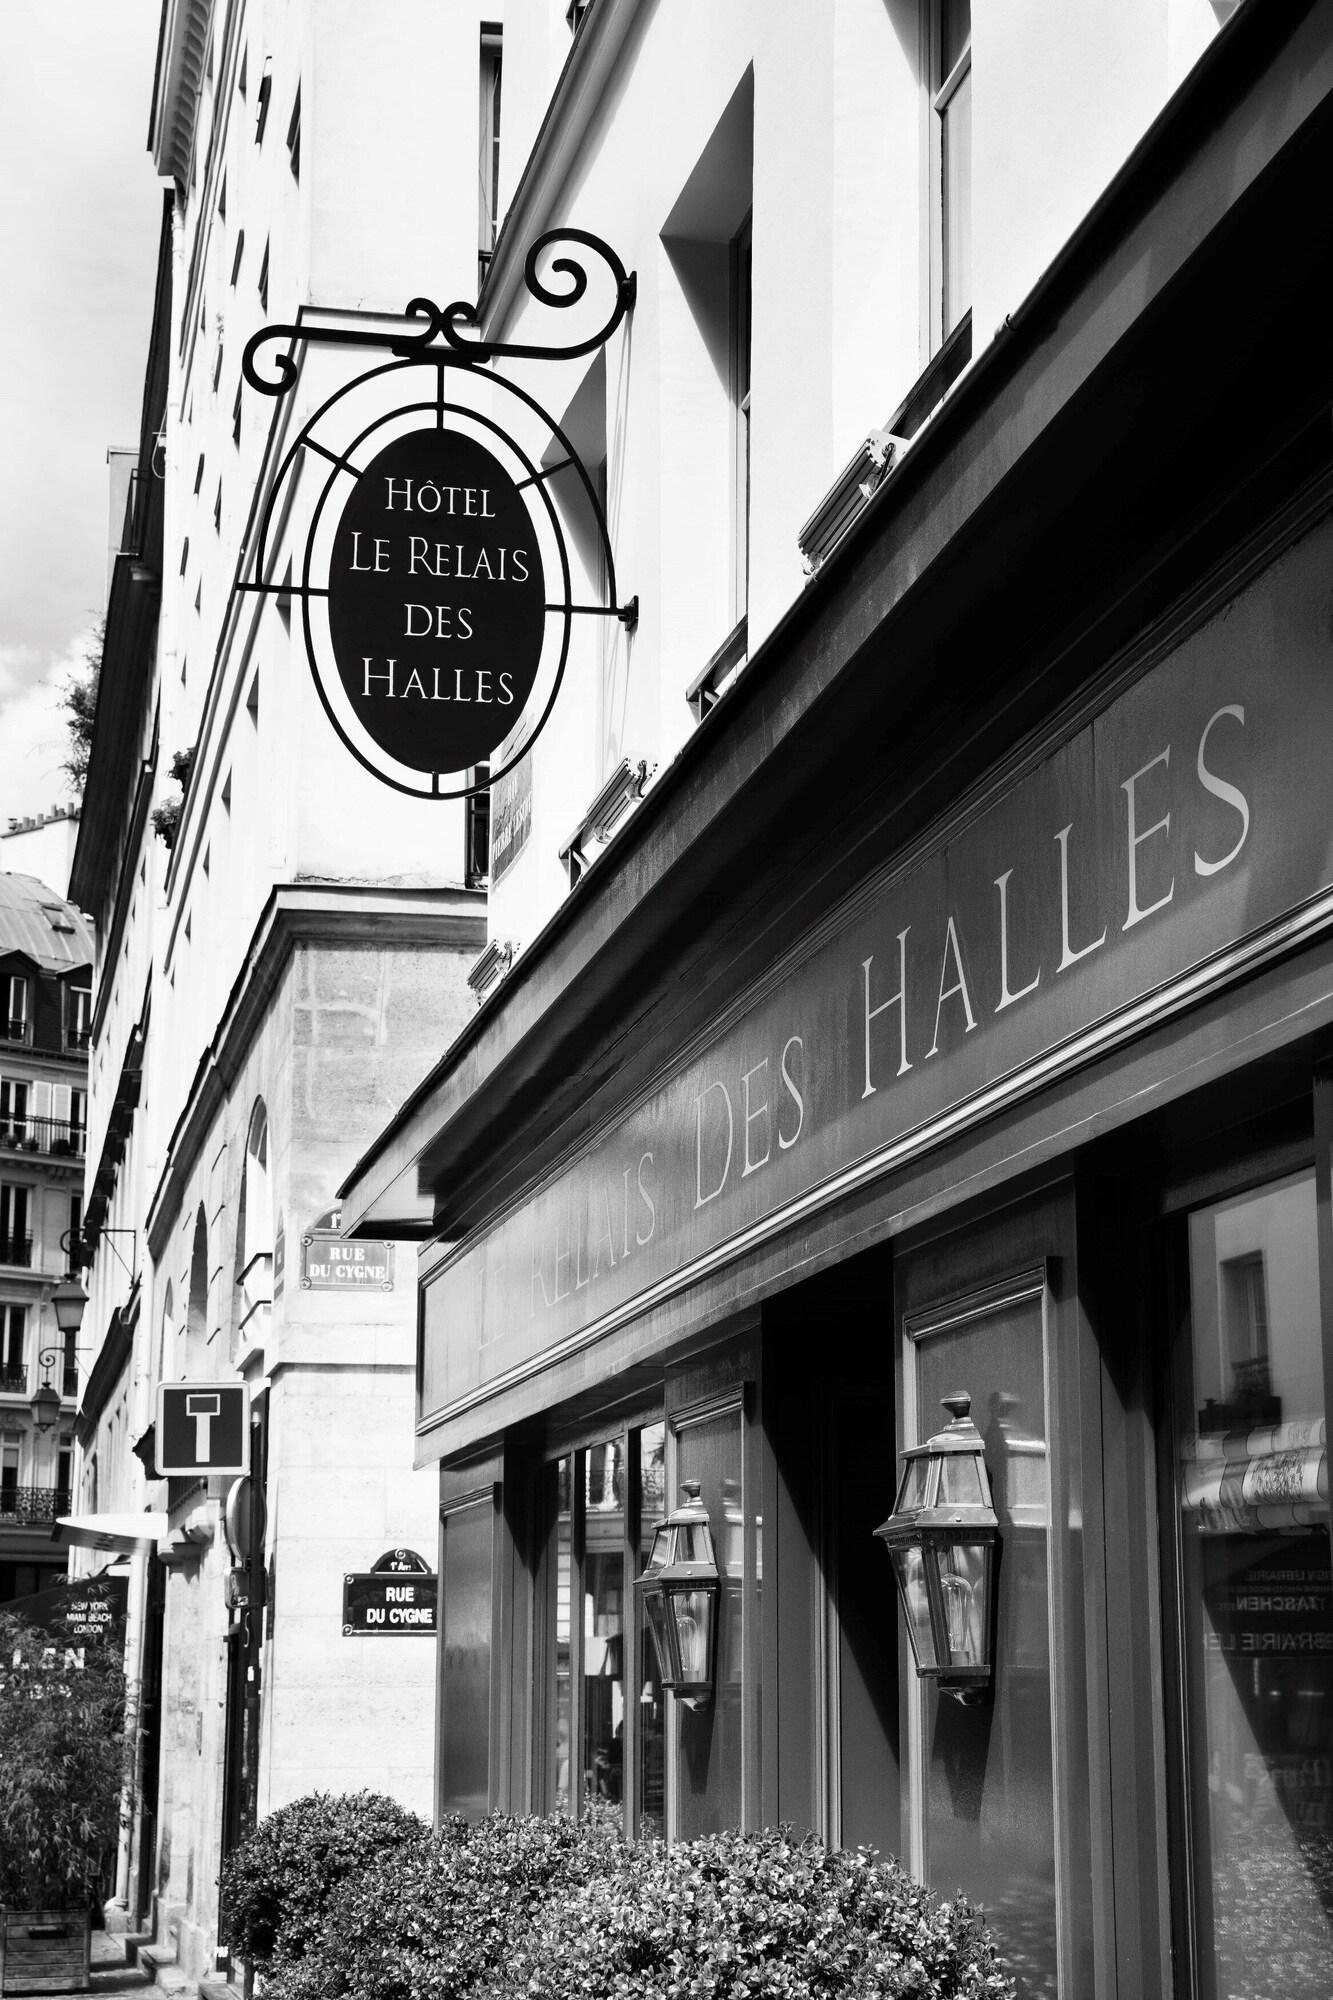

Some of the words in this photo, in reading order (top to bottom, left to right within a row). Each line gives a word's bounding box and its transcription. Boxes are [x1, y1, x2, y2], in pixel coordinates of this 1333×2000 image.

[384, 477, 496, 518] HÔTEL
[349, 531, 391, 573] LE
[407, 536, 530, 583] RELAIS
[404, 603, 474, 640] DES
[361, 657, 515, 706] HALLES
[529, 1151, 657, 1319] RELAIS
[694, 1036, 804, 1210] DES
[861, 704, 1250, 1099] HALLES
[329, 1247, 365, 1261] RUE
[309, 1264, 331, 1277] DU
[335, 1265, 385, 1279] CYGNE
[385, 1586, 415, 1602] RUE
[66, 1613, 87, 1622] MIAMI
[88, 1613, 112, 1622] BEACH
[366, 1608, 386, 1623] DU
[389, 1608, 433, 1624] CYGNE
[73, 1624, 104, 1634] LONDON
